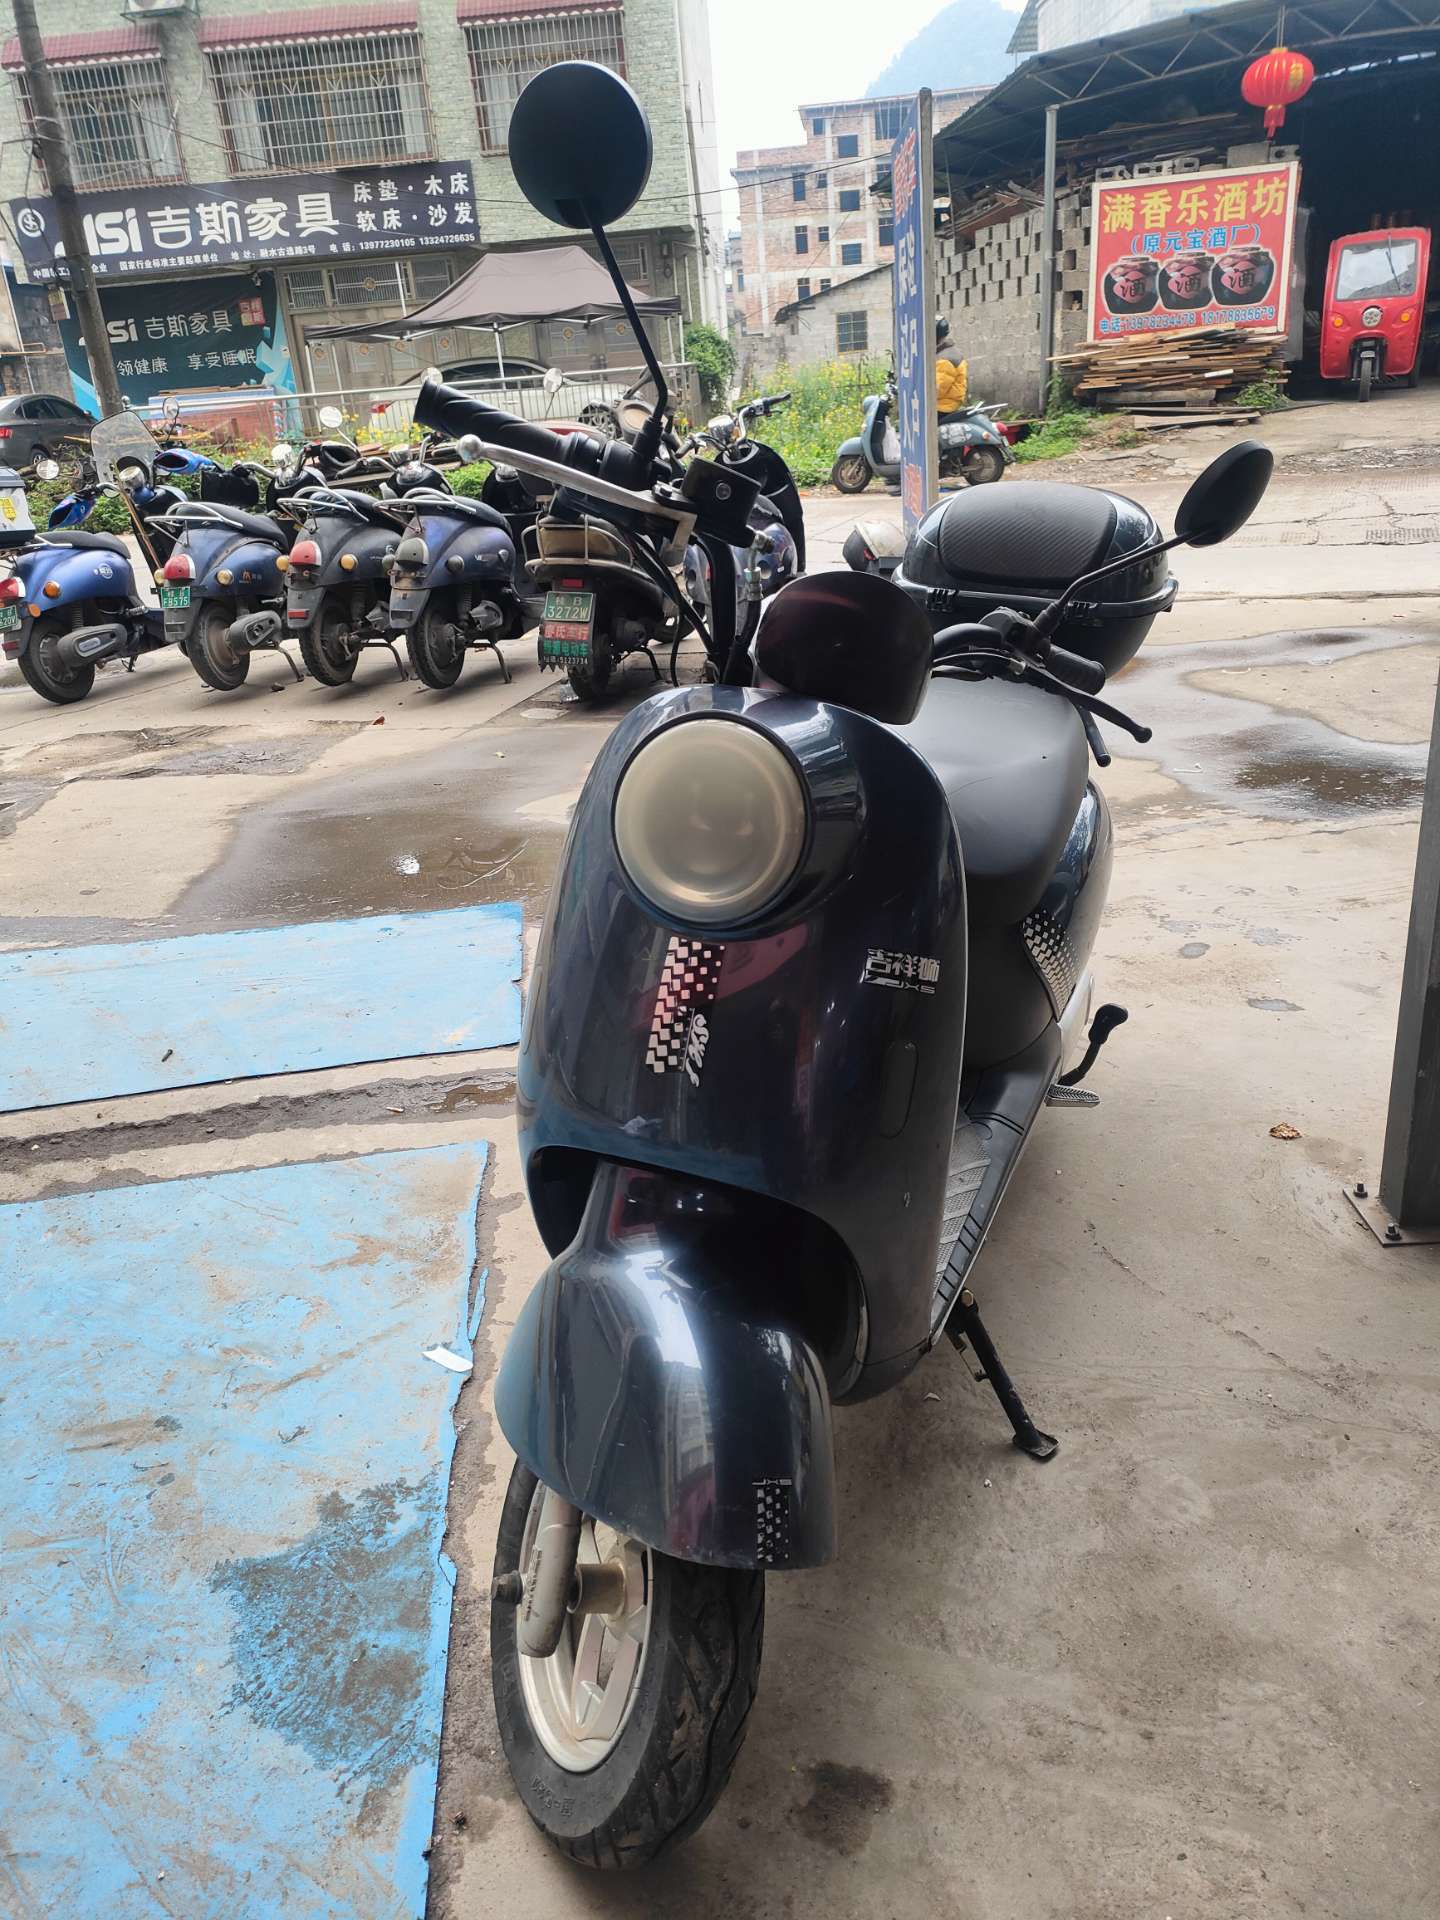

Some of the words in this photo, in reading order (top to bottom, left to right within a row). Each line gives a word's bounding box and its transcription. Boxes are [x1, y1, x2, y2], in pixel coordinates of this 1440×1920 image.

[1103, 176, 1288, 233] 满香乐酒坊
[147, 192, 340, 249] 吉斯家具
[144, 311, 232, 340] 吉斯家具
[116, 356, 169, 376] 领健康
[187, 348, 257, 370] 享受睡眠
[547, 606, 588, 619] 3272W
